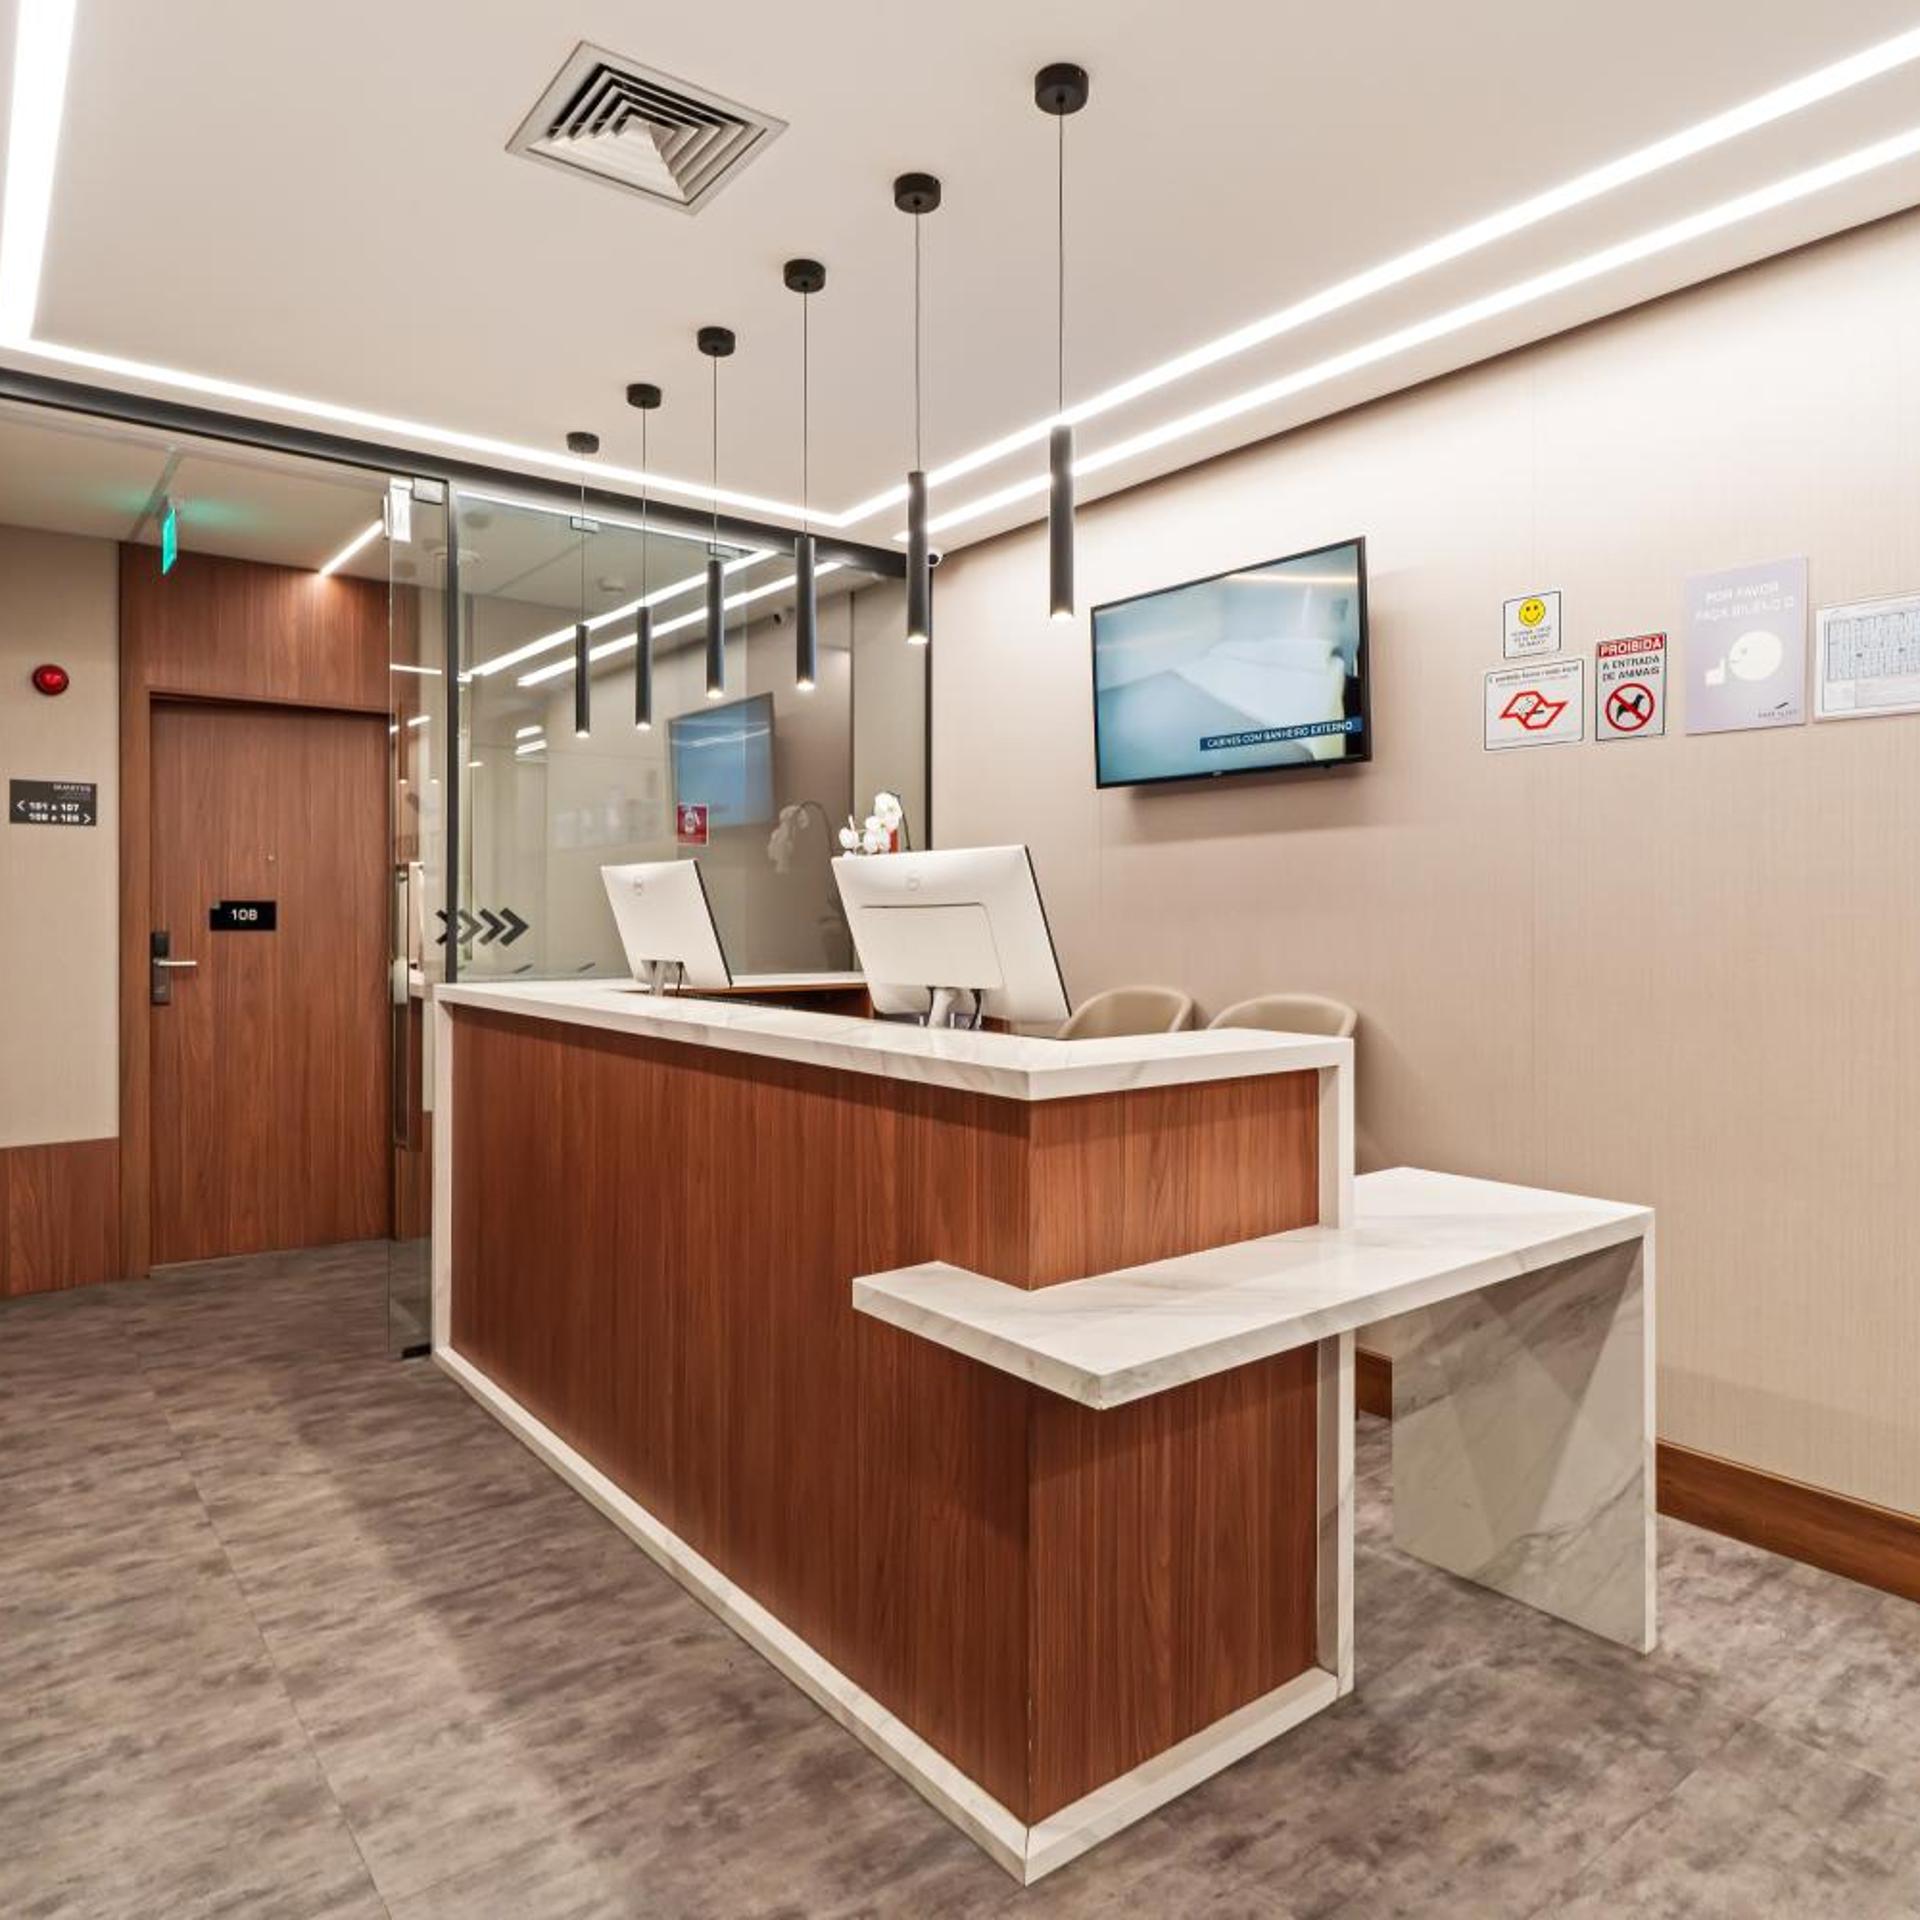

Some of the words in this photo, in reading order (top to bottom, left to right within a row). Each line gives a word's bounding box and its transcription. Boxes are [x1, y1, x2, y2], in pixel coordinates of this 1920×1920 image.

[1601, 638, 1662, 656] PROIBIDA
[1612, 655, 1660, 669] ENTRADA
[1603, 671, 1615, 682] DE
[1618, 666, 1660, 679] ANIMAIS
[1242, 733, 1262, 744] COM
[1311, 721, 1353, 735] EXTERNO
[231, 908, 258, 921] 108
